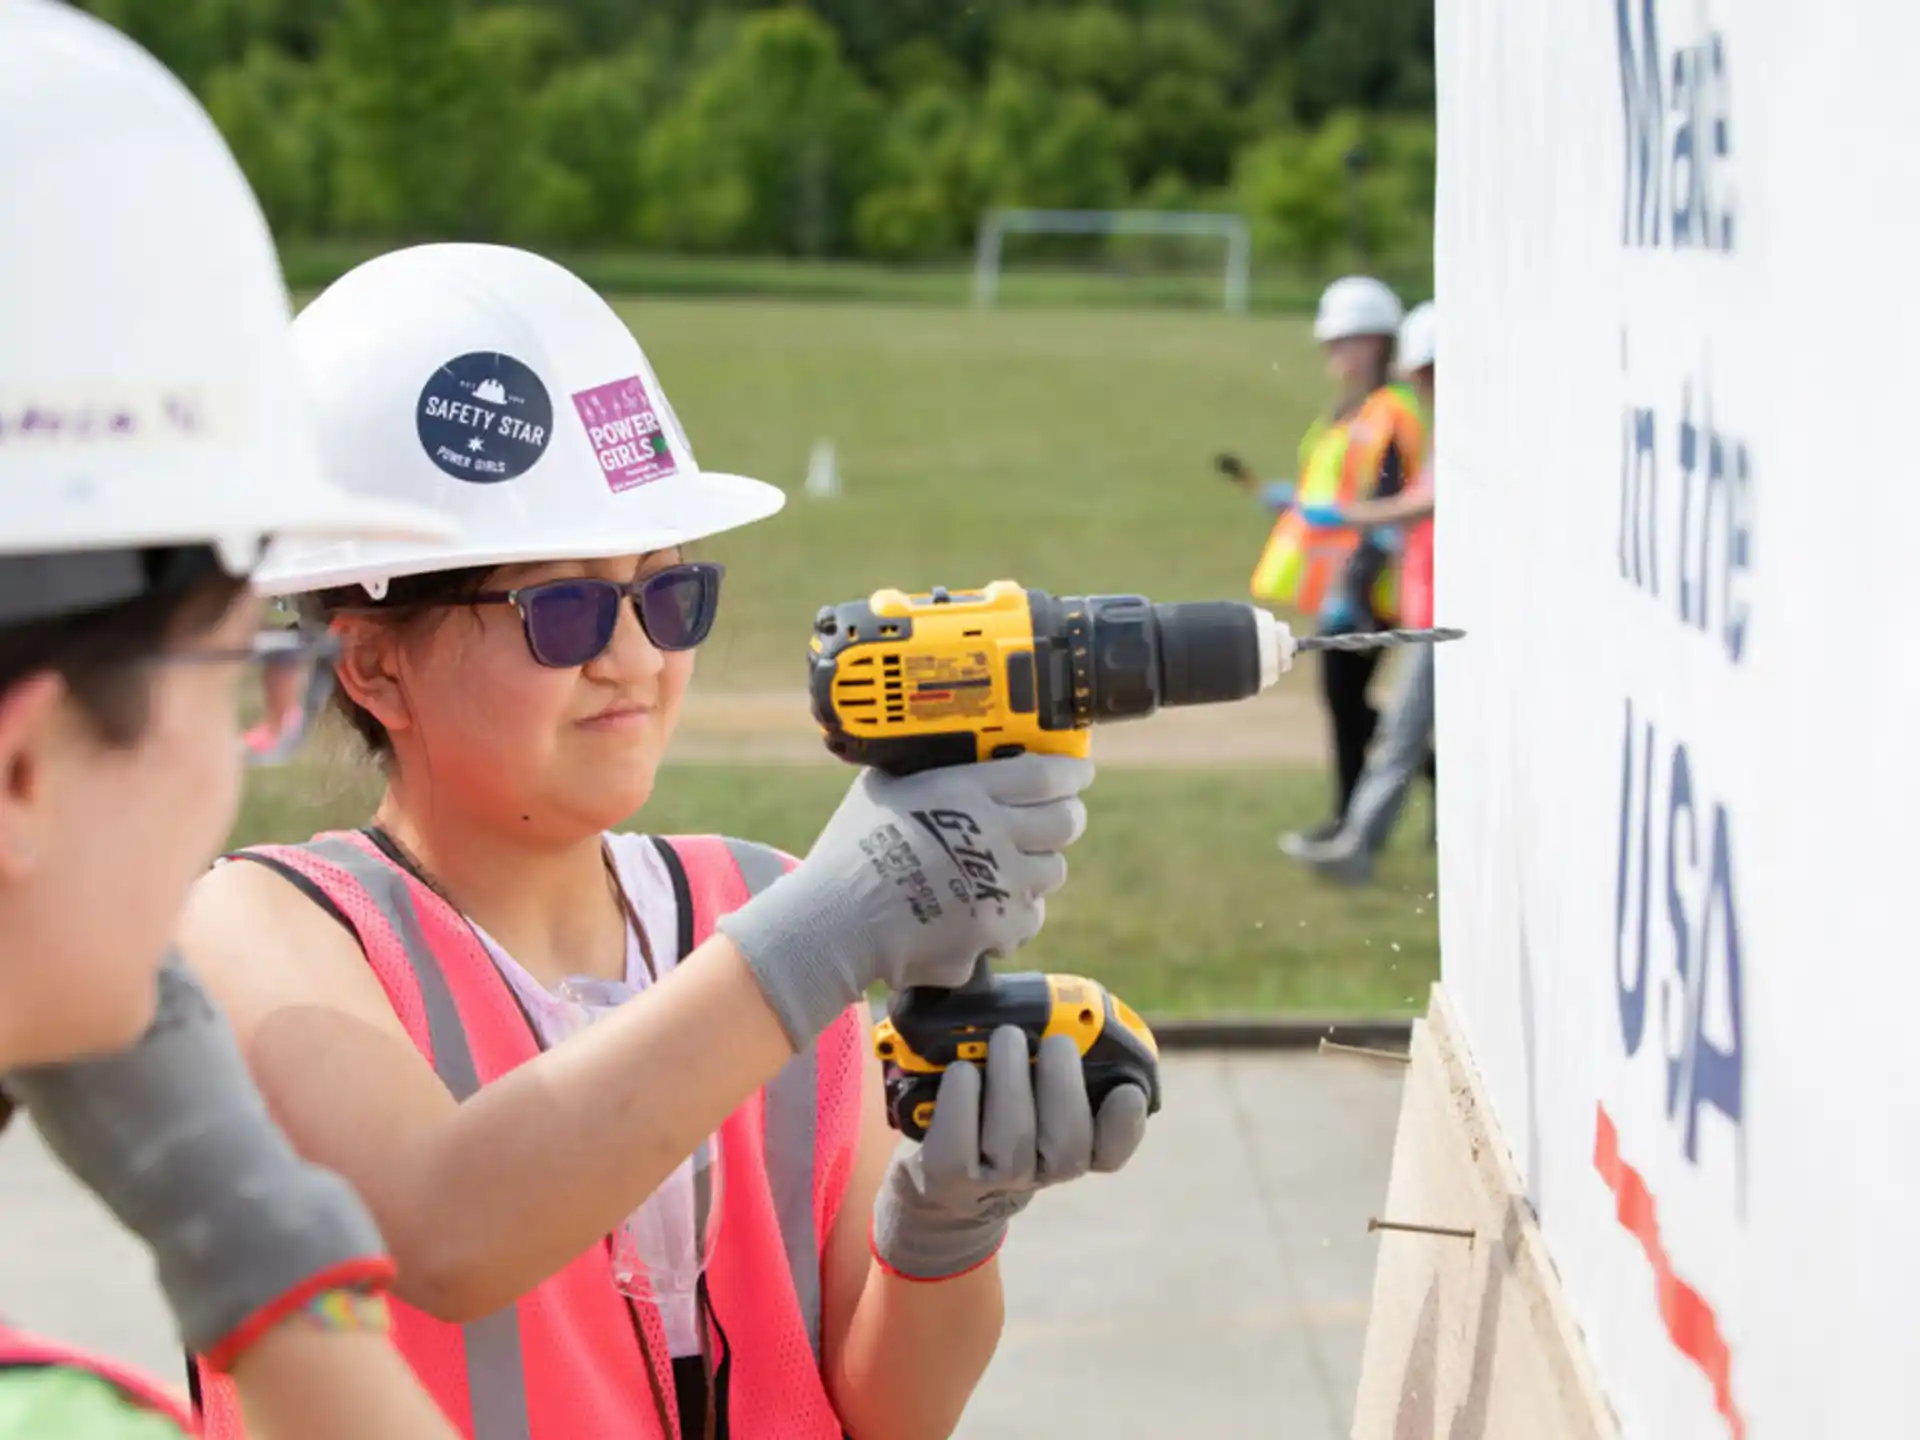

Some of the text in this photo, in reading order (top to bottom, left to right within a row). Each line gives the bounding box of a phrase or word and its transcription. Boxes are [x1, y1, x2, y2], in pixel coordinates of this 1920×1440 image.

[425, 396, 545, 447] SAFETY STAR
[589, 411, 661, 450] POWER
[436, 445, 505, 472] POWER GIRLS
[600, 437, 655, 472] GIRLS
[1617, 322, 1750, 664] in the
[929, 809, 1011, 904] G-Tek
[1616, 696, 1745, 1185] USA
